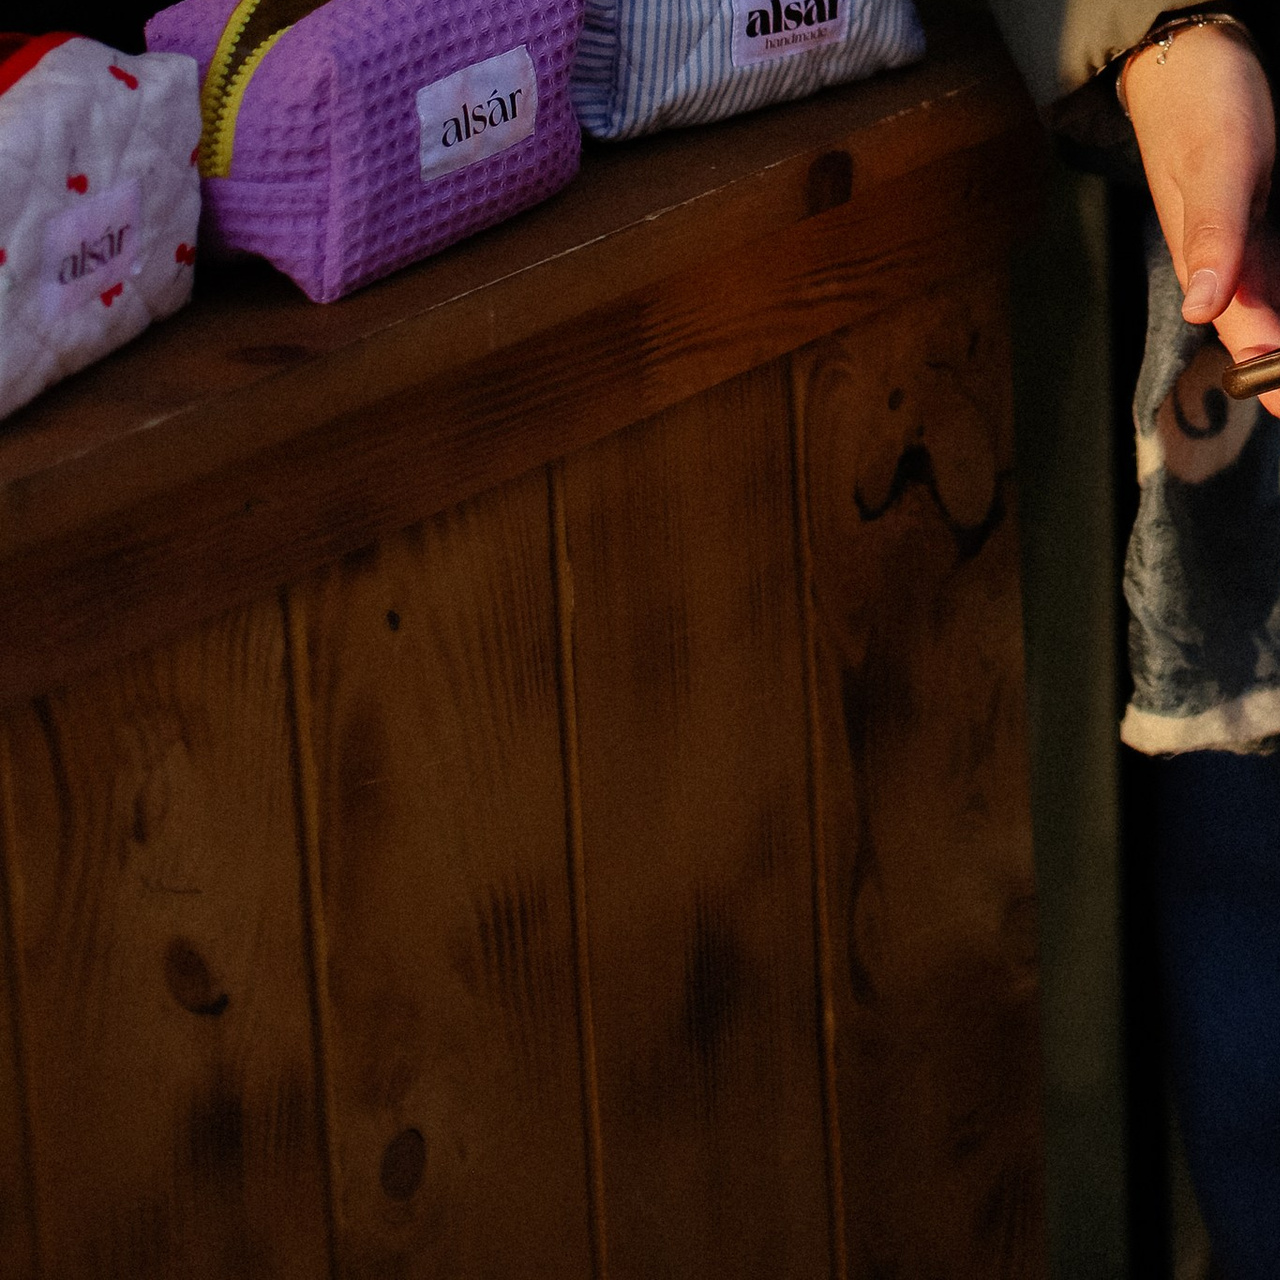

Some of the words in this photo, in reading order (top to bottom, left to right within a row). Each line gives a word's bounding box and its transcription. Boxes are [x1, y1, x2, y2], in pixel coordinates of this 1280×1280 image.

[765, 26, 829, 50] handmade
[442, 88, 522, 148] alsár
[58, 224, 131, 285] alsár
